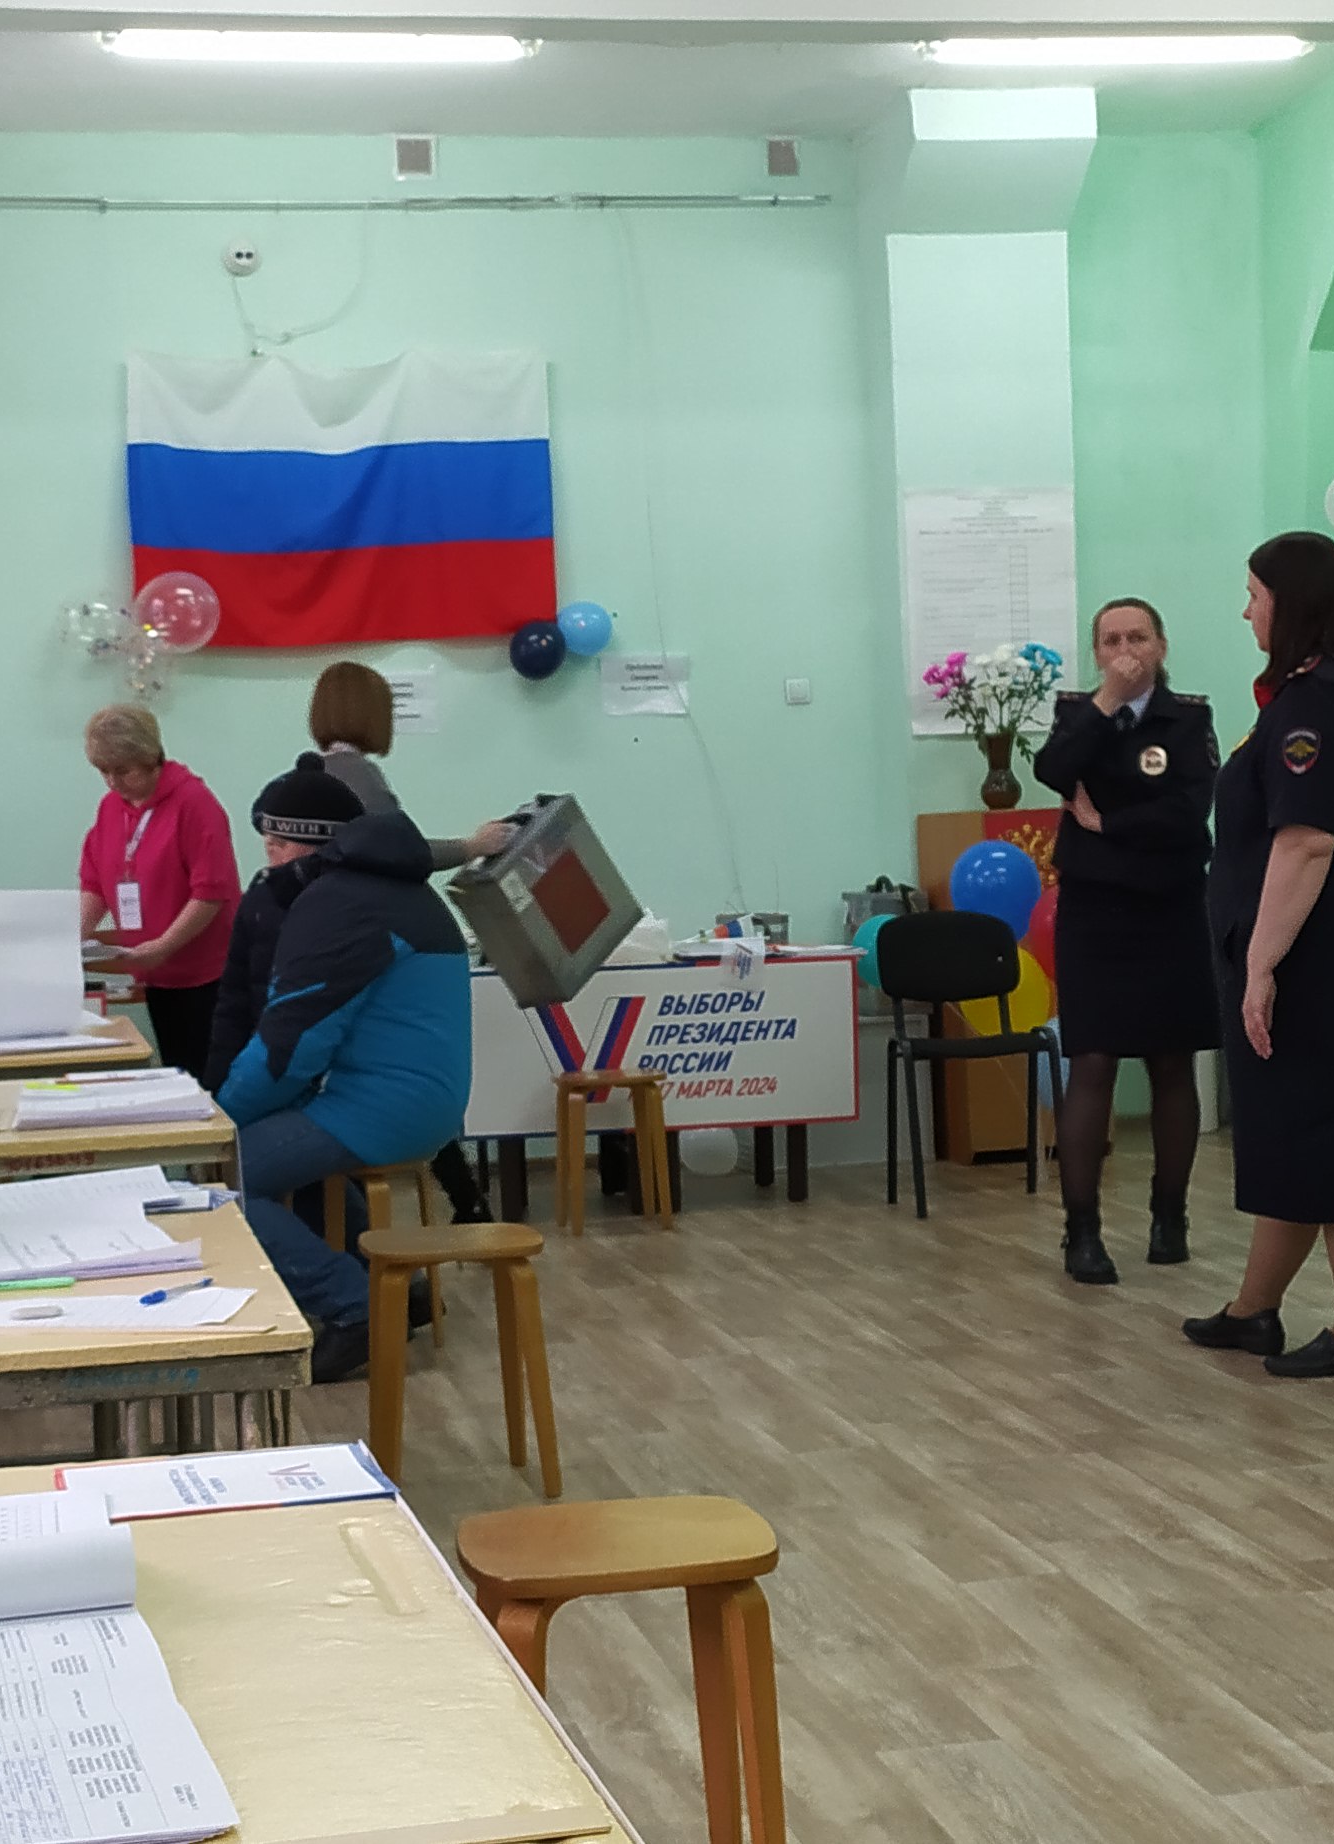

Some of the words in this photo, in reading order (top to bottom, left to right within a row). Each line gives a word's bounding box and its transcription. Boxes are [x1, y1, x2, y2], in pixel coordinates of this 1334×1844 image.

[658, 991, 765, 1016] ВЫБОРЫ
[646, 1018, 798, 1046] ПРЕЗИДЕНТА
[638, 1050, 733, 1075] РОССИИ
[676, 1078, 734, 1099] МАРТА
[736, 1076, 778, 1096] 2024
